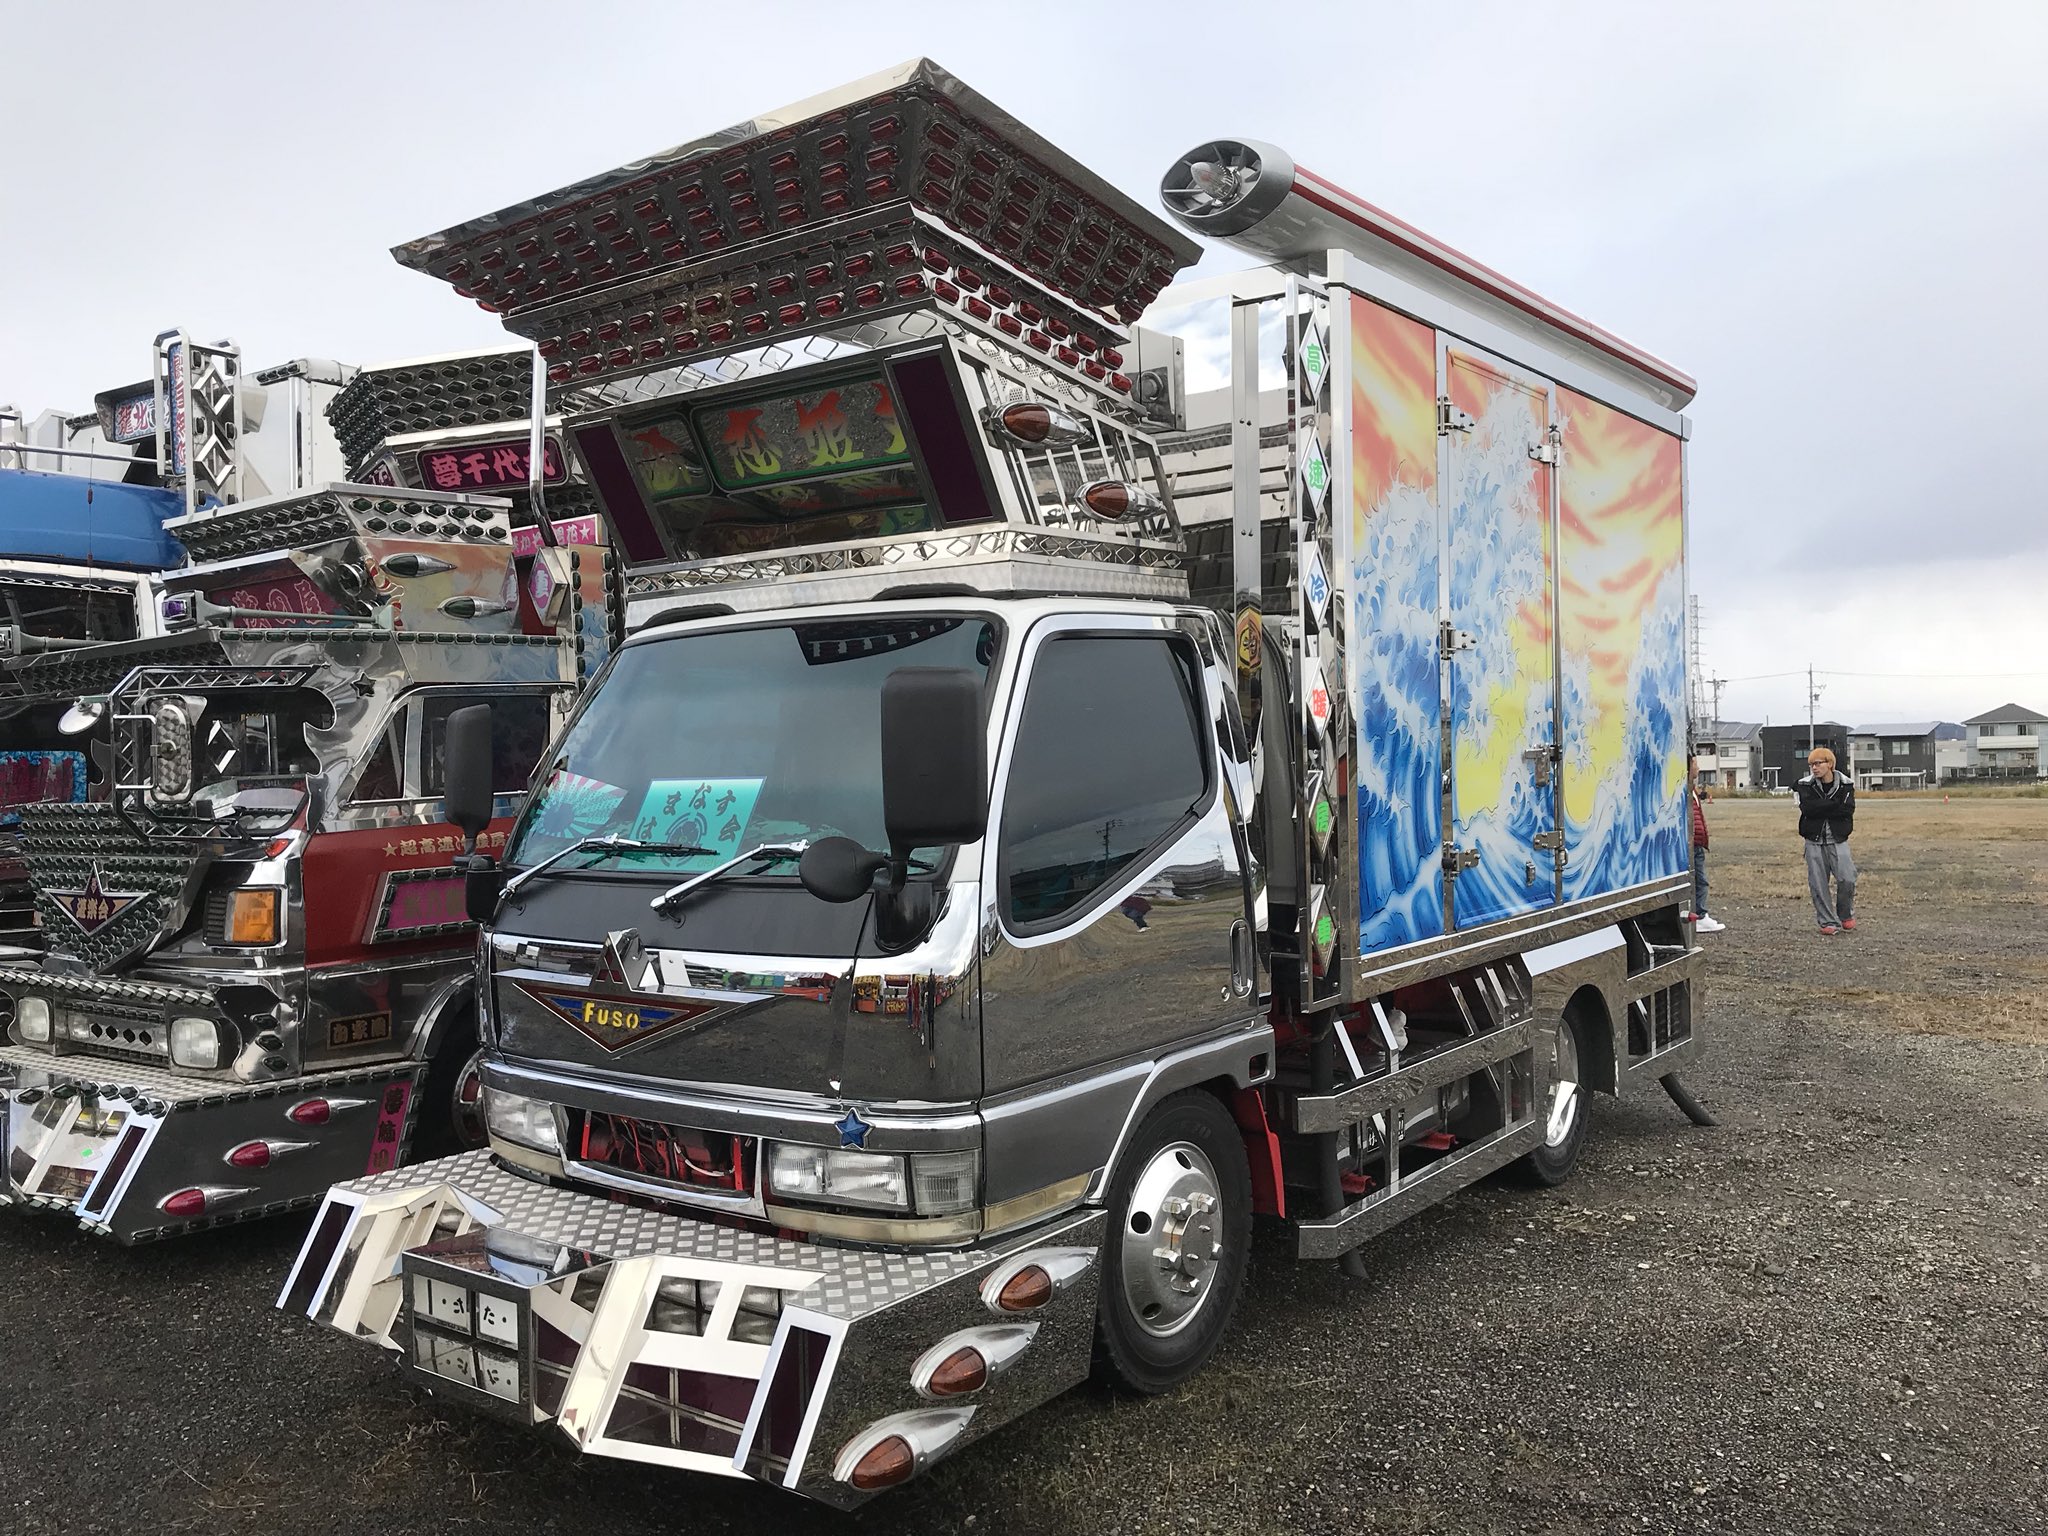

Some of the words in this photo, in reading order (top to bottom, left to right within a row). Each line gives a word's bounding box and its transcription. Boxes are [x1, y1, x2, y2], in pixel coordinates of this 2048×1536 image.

[399, 831, 511, 857] 超高速冷暖房
